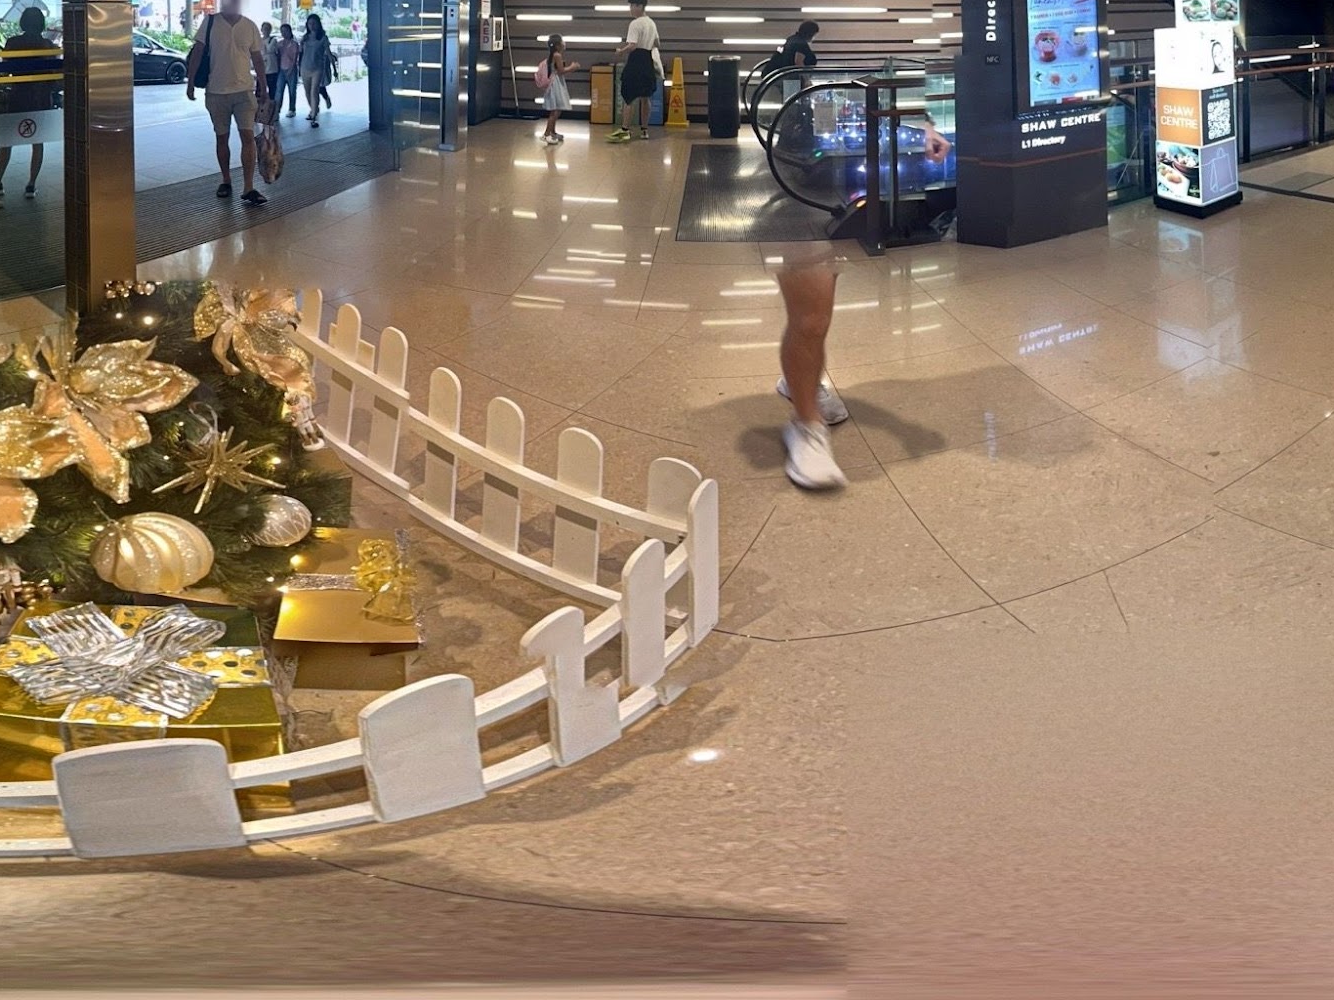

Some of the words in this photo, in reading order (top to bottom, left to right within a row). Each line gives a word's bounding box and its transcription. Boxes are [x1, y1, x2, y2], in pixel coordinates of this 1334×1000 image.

[1162, 104, 1195, 118] SHAW
[1020, 119, 1057, 134] SHAW
[1060, 112, 1102, 128] CENTRE
[1160, 115, 1199, 130] CENTRE
[1031, 135, 1066, 148] Directory
